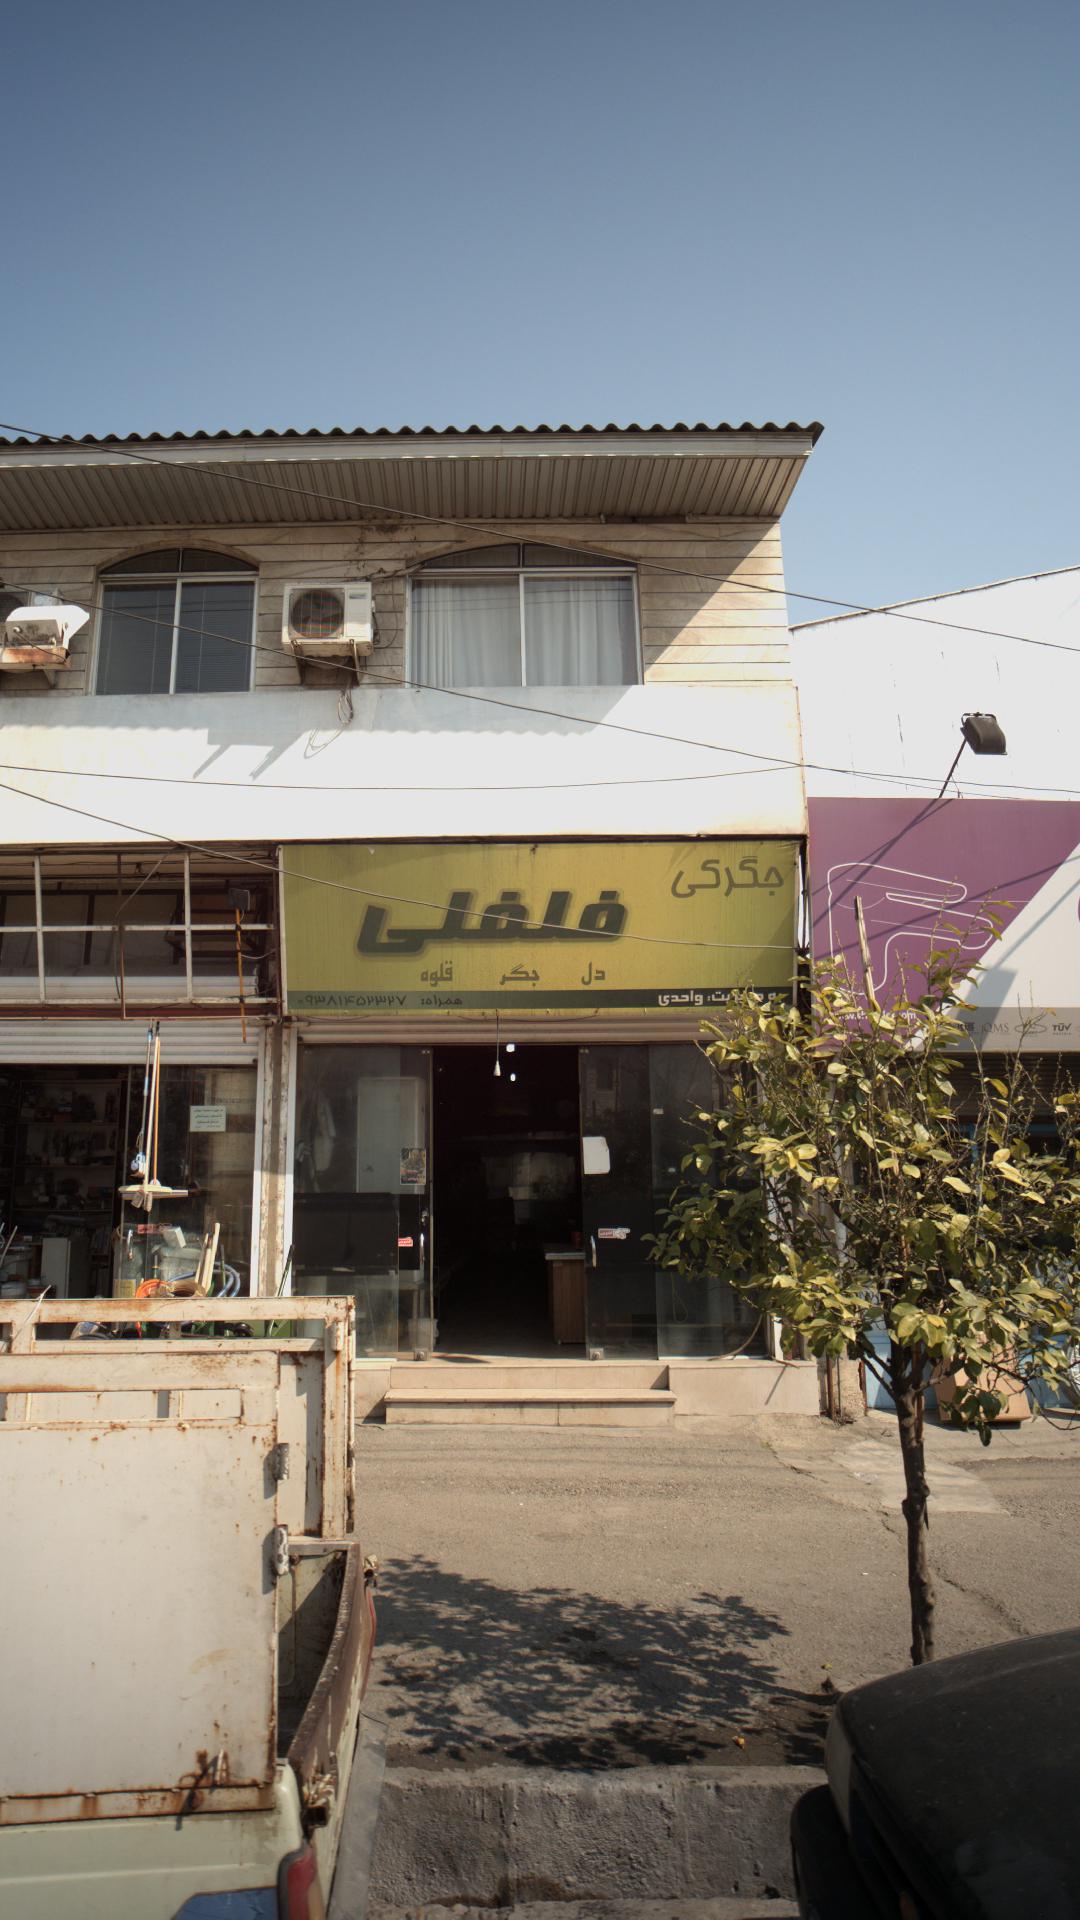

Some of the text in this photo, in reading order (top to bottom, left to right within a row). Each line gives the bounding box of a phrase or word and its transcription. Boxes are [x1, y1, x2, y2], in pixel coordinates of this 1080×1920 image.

[671, 856, 784, 898] جگرکی
[356, 889, 627, 955] فلفلی
[421, 960, 605, 988] دل جگر قلوه
[658, 990, 703, 1006] واحدی
